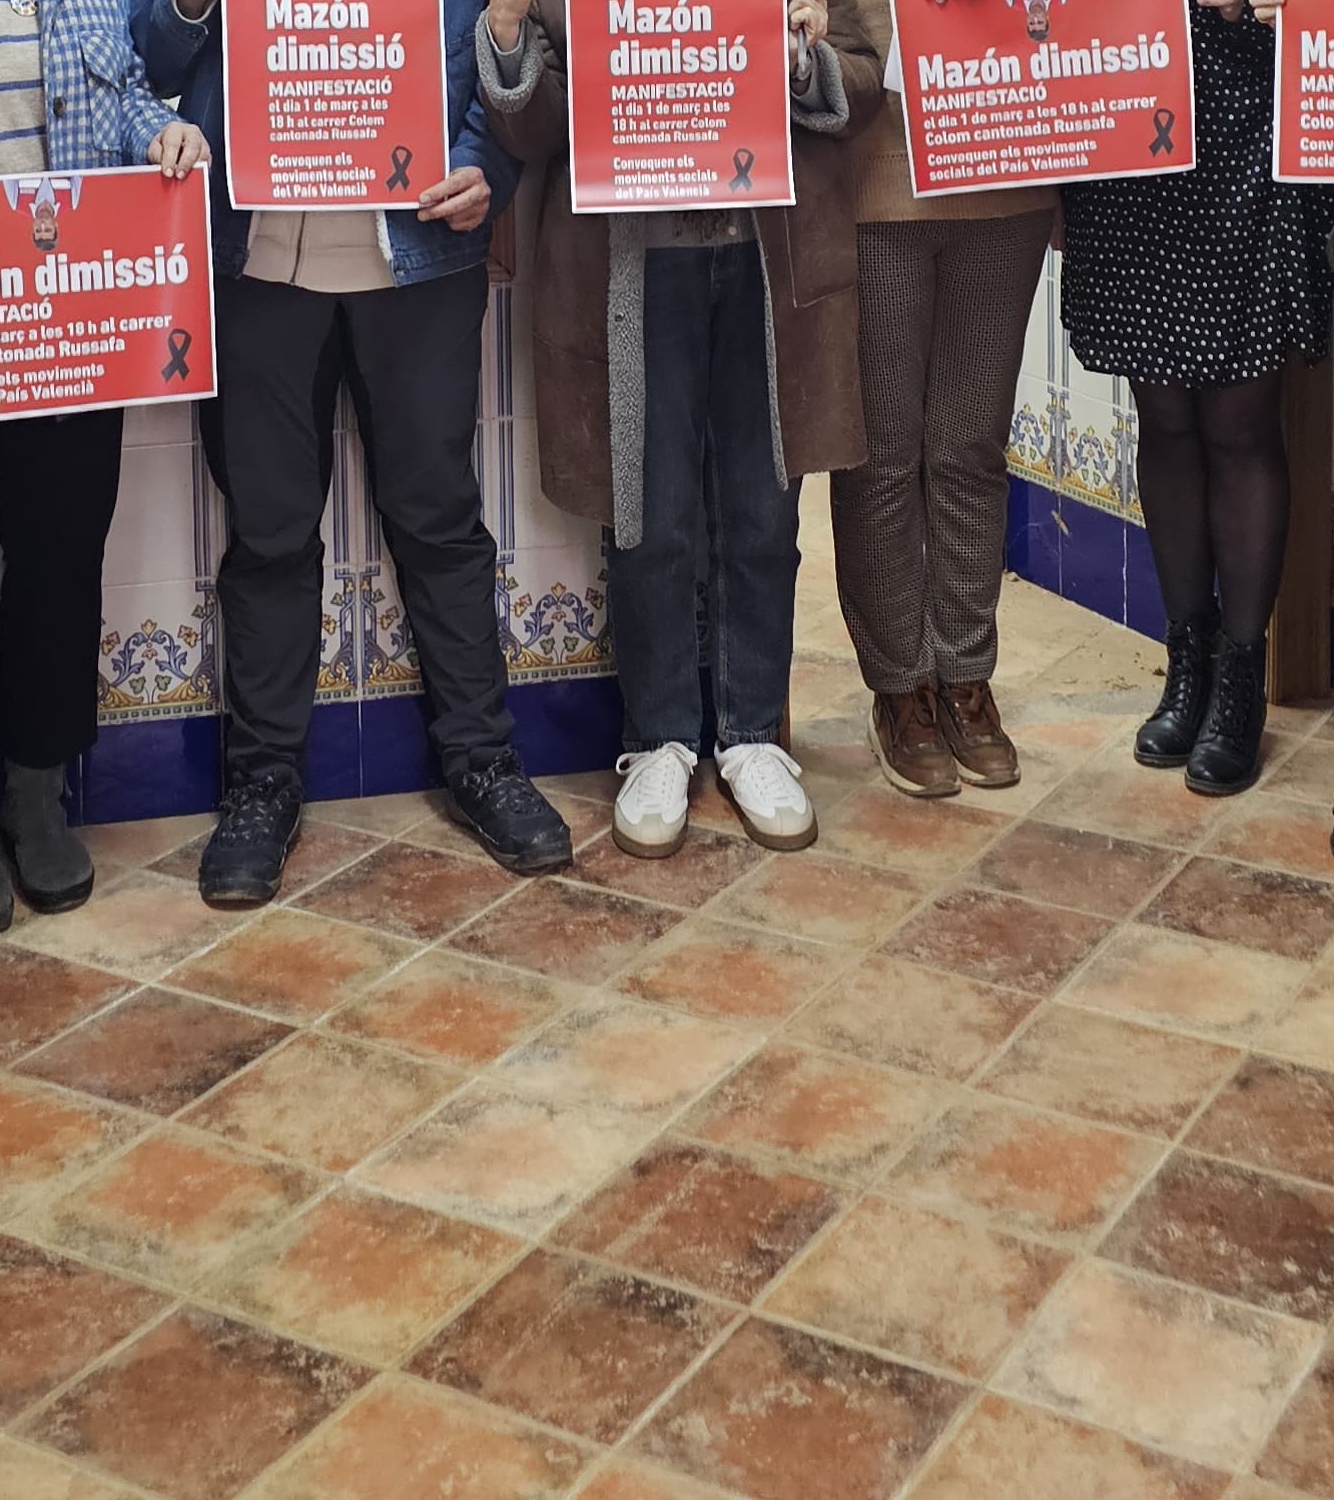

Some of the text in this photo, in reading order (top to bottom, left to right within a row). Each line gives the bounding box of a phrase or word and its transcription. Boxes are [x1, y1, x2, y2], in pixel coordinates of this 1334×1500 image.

[267, 33, 405, 72] dimissió
[610, 35, 747, 76] dimissió
[918, 31, 1170, 91] Mazón dimissió
[269, 75, 392, 97] MANIFESTACIÓ
[611, 77, 734, 101] MANIFESTACIÓ
[921, 82, 1047, 113] MANIFESTACIÓ
[924, 116, 936, 130] el
[960, 113, 967, 125] 1
[971, 112, 987, 124] de
[990, 110, 1023, 122] març
[1027, 109, 1034, 119] a
[1037, 106, 1057, 117] les
[1060, 102, 1077, 115] 18
[1079, 101, 1088, 114] h
[1091, 98, 1106, 113] al
[1109, 96, 1157, 111] carrer
[1300, 97, 1314, 111] el
[925, 115, 1115, 147] Colom cantonada Russafa
[927, 139, 1097, 166] Convoquen els moviments
[929, 153, 1088, 181] socials del País Valencià
[35, 243, 188, 295] dimissió
[29, 329, 37, 340] a
[41, 325, 63, 339] les
[67, 321, 85, 336] 18
[87, 320, 97, 334] h
[100, 316, 116, 333] al
[119, 315, 172, 332] carrer
[59, 336, 125, 357] Russafa
[24, 363, 105, 383] moviments
[31, 380, 94, 400] Valencià
